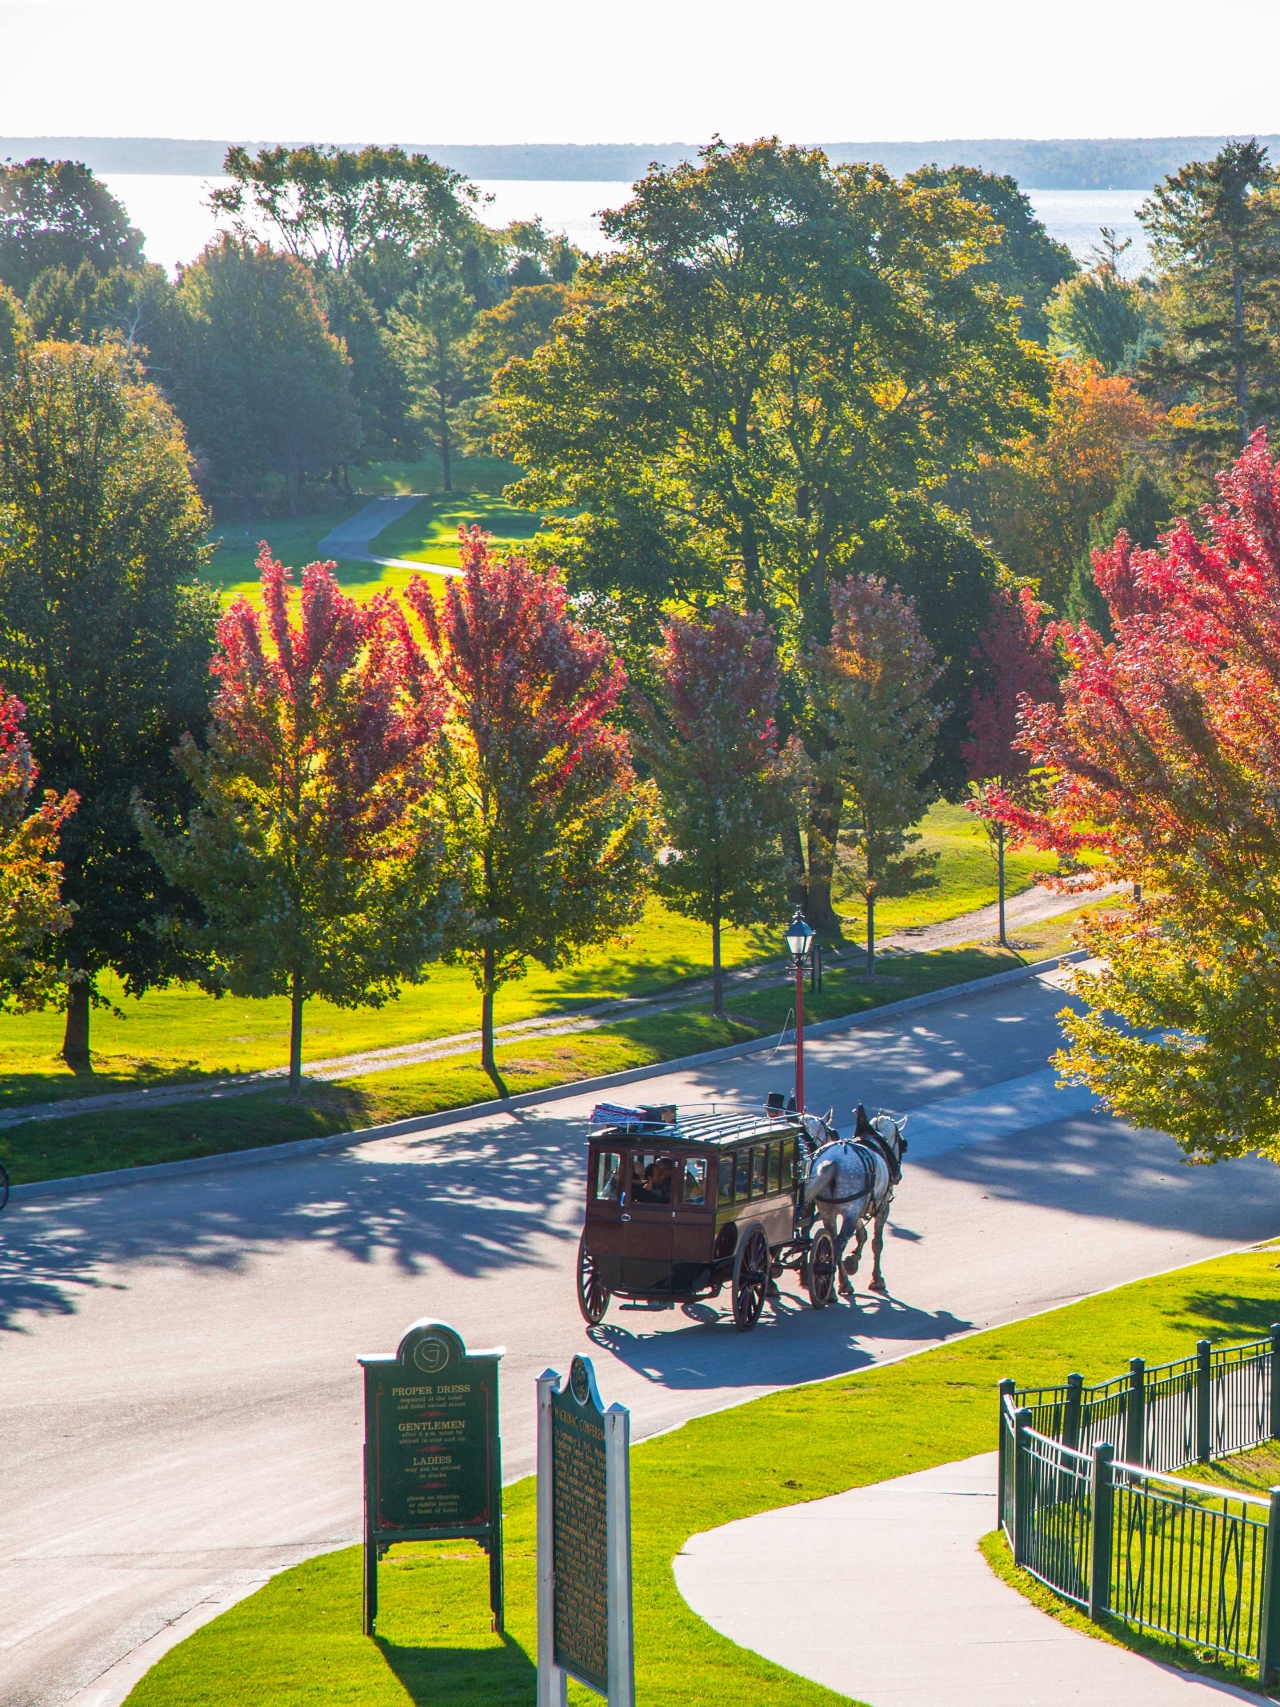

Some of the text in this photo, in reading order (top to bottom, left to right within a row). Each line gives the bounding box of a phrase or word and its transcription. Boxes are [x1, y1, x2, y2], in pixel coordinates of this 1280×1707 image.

[392, 1384, 471, 1396] PROPER DRESS
[398, 1420, 466, 1431] GENTLEMEN
[413, 1456, 452, 1466] LADIES
